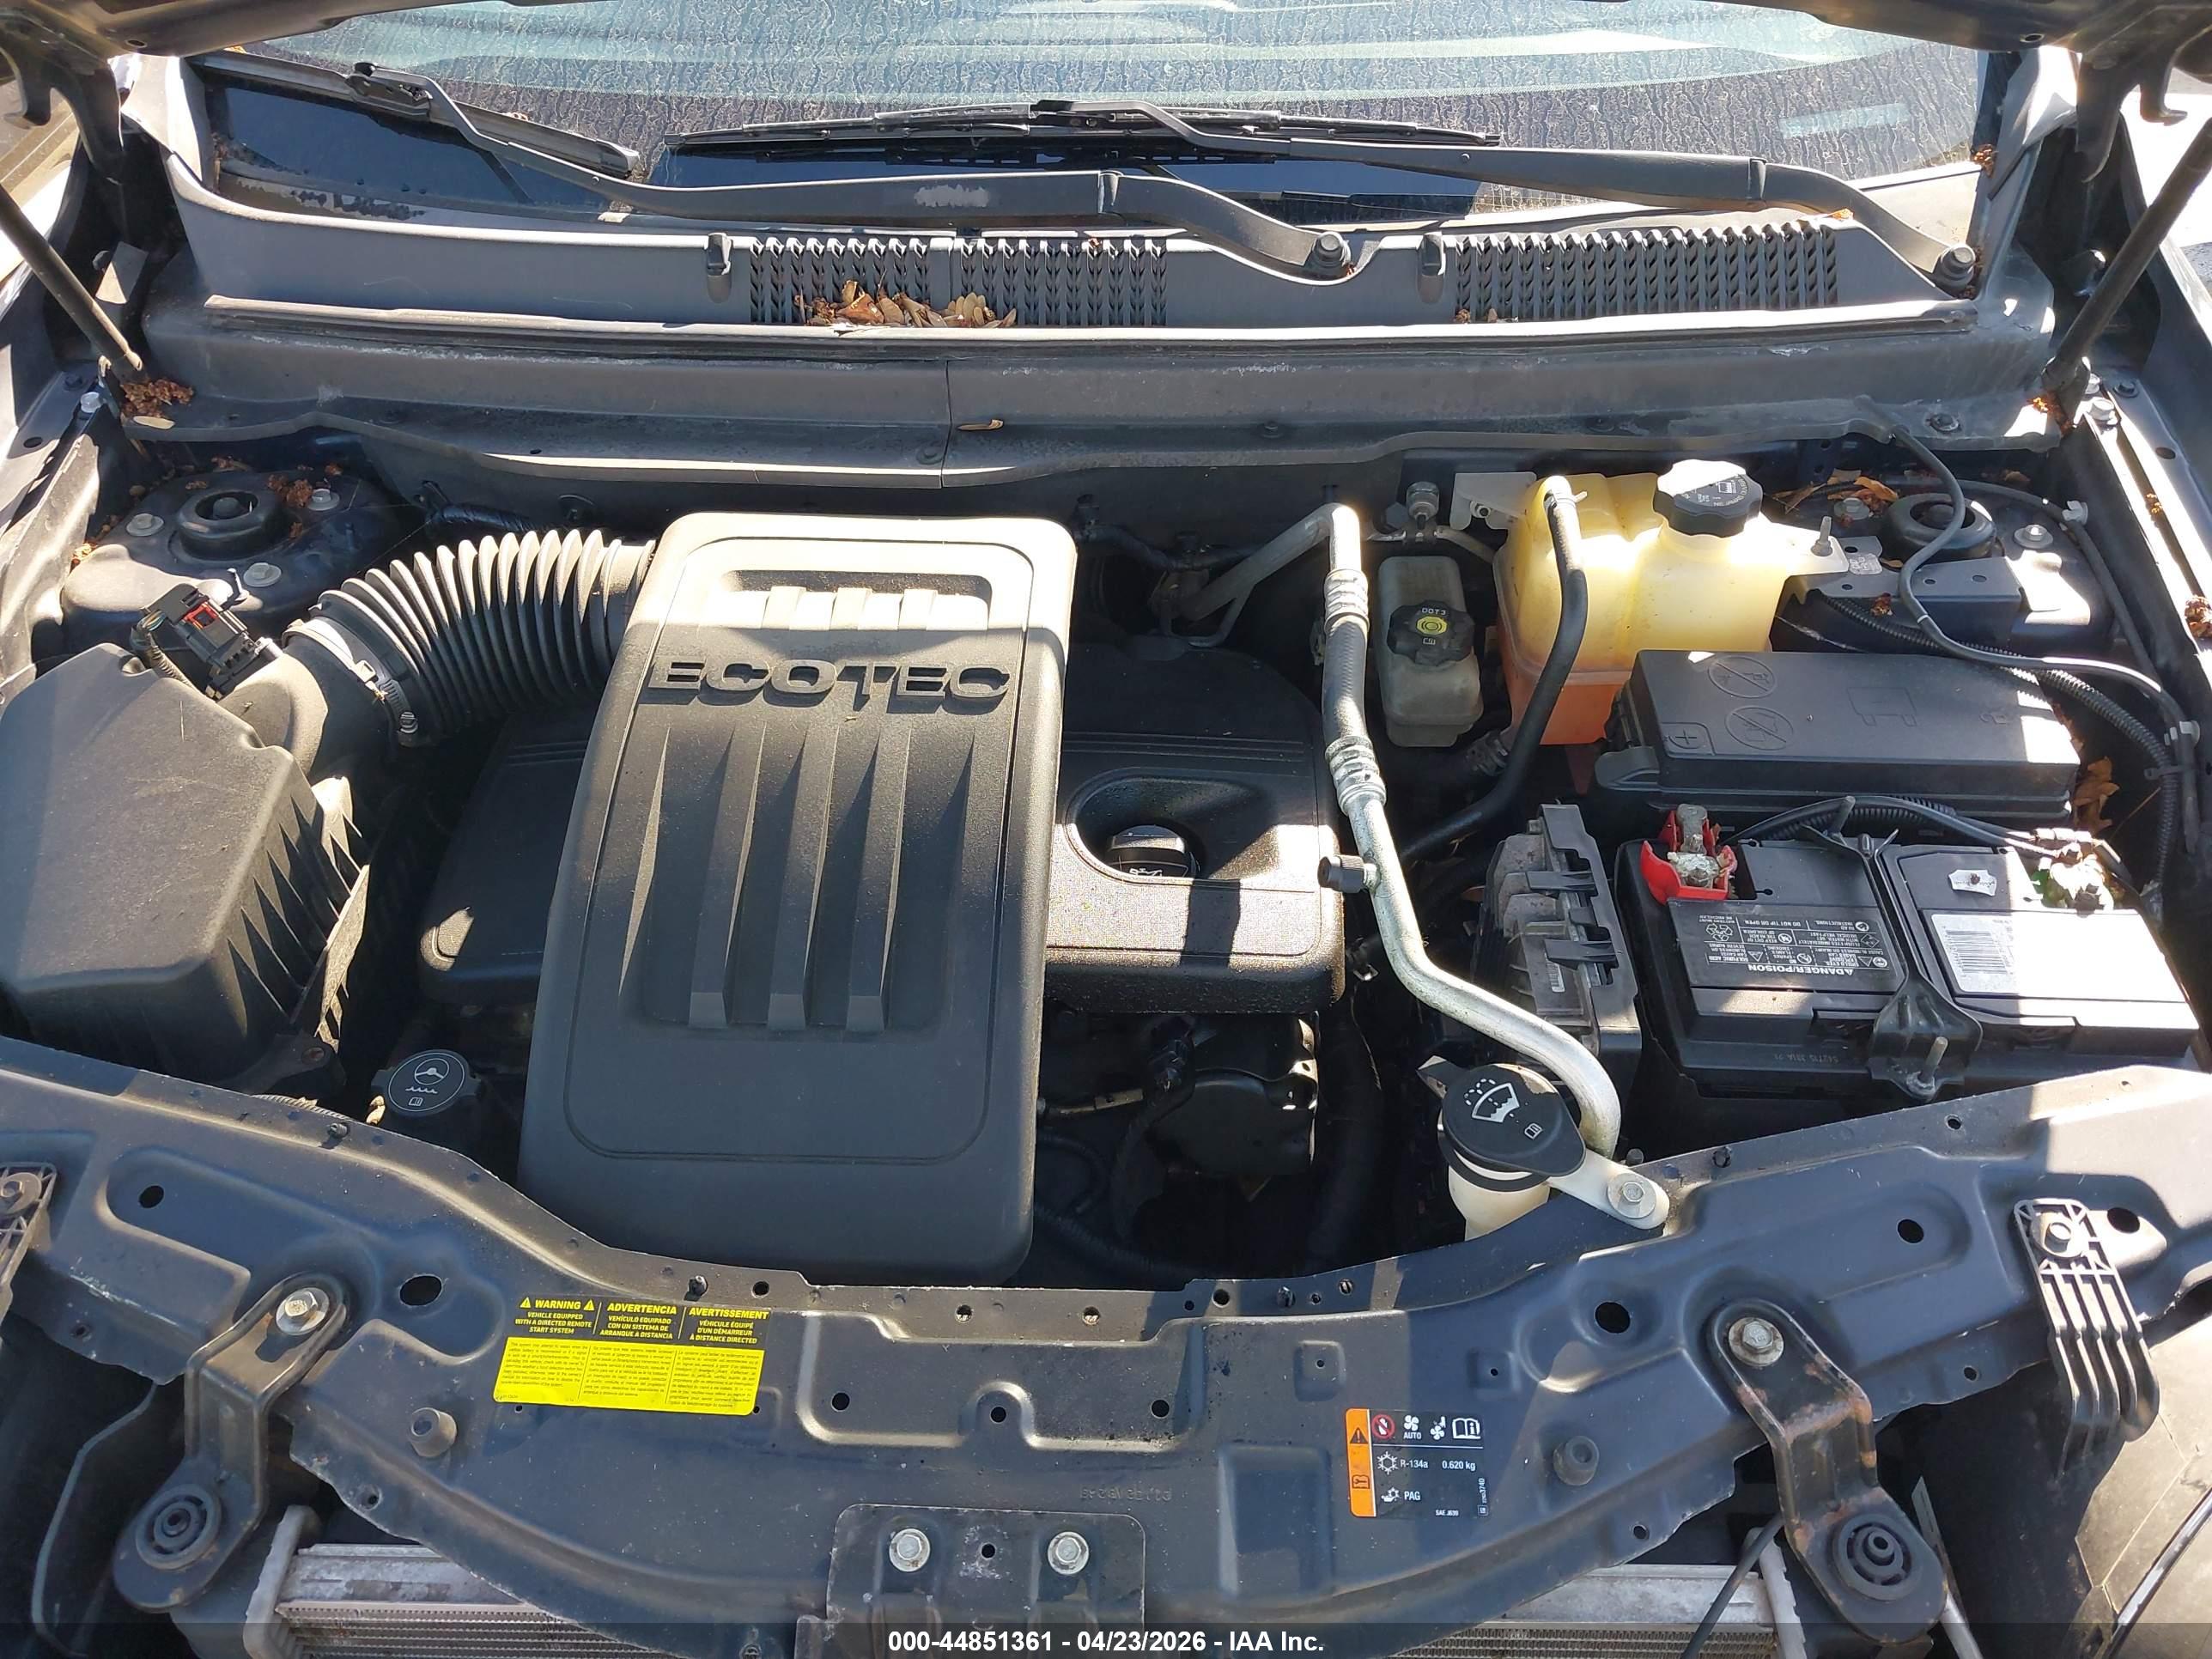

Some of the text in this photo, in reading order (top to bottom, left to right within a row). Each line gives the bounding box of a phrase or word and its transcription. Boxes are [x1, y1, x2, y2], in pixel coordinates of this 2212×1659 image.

[648, 659, 1011, 700] ECOTEC
[1747, 964, 1844, 975] DANGER/POISON
[535, 1300, 581, 1310] WARNING
[607, 1304, 677, 1314] ADVERTENCIA
[689, 1308, 769, 1319] AVERTISSEMENT
[699, 1319, 729, 1328] VÉHICULE
[1401, 1459, 1476, 1472] R-134a 0.620 kg
[1404, 1491, 1421, 1500] PAG
